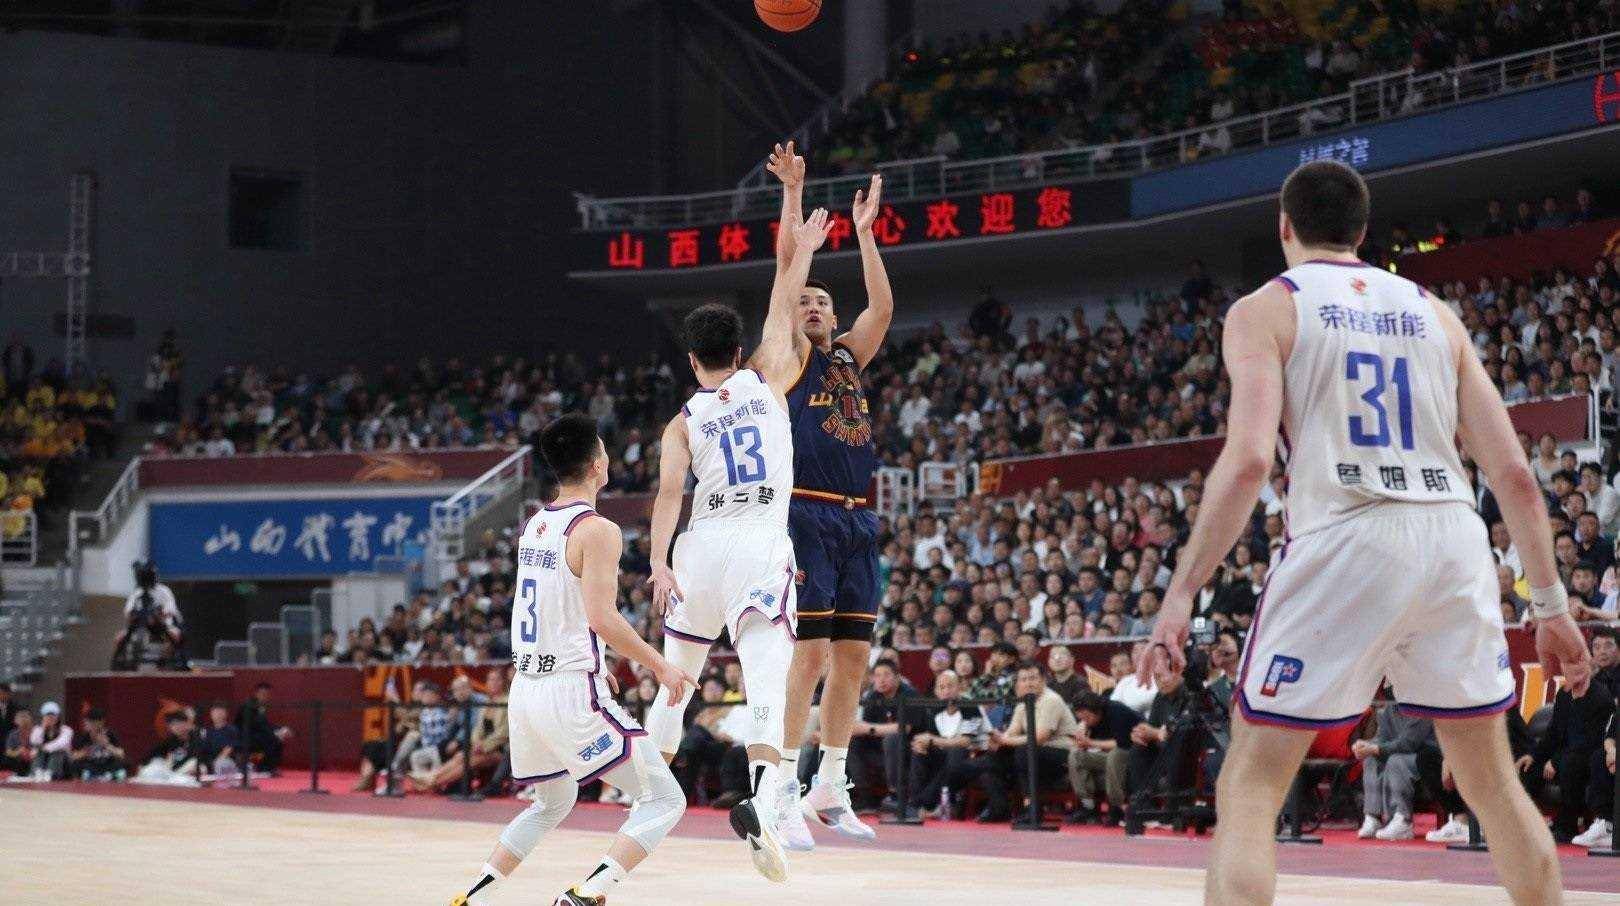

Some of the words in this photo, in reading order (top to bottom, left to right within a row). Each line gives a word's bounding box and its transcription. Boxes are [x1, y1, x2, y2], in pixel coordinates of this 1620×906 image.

[1346, 351, 1415, 450] 31
[719, 425, 767, 486] 13
[1336, 462, 1450, 492] 詹姆斯
[520, 578, 537, 643] 3
